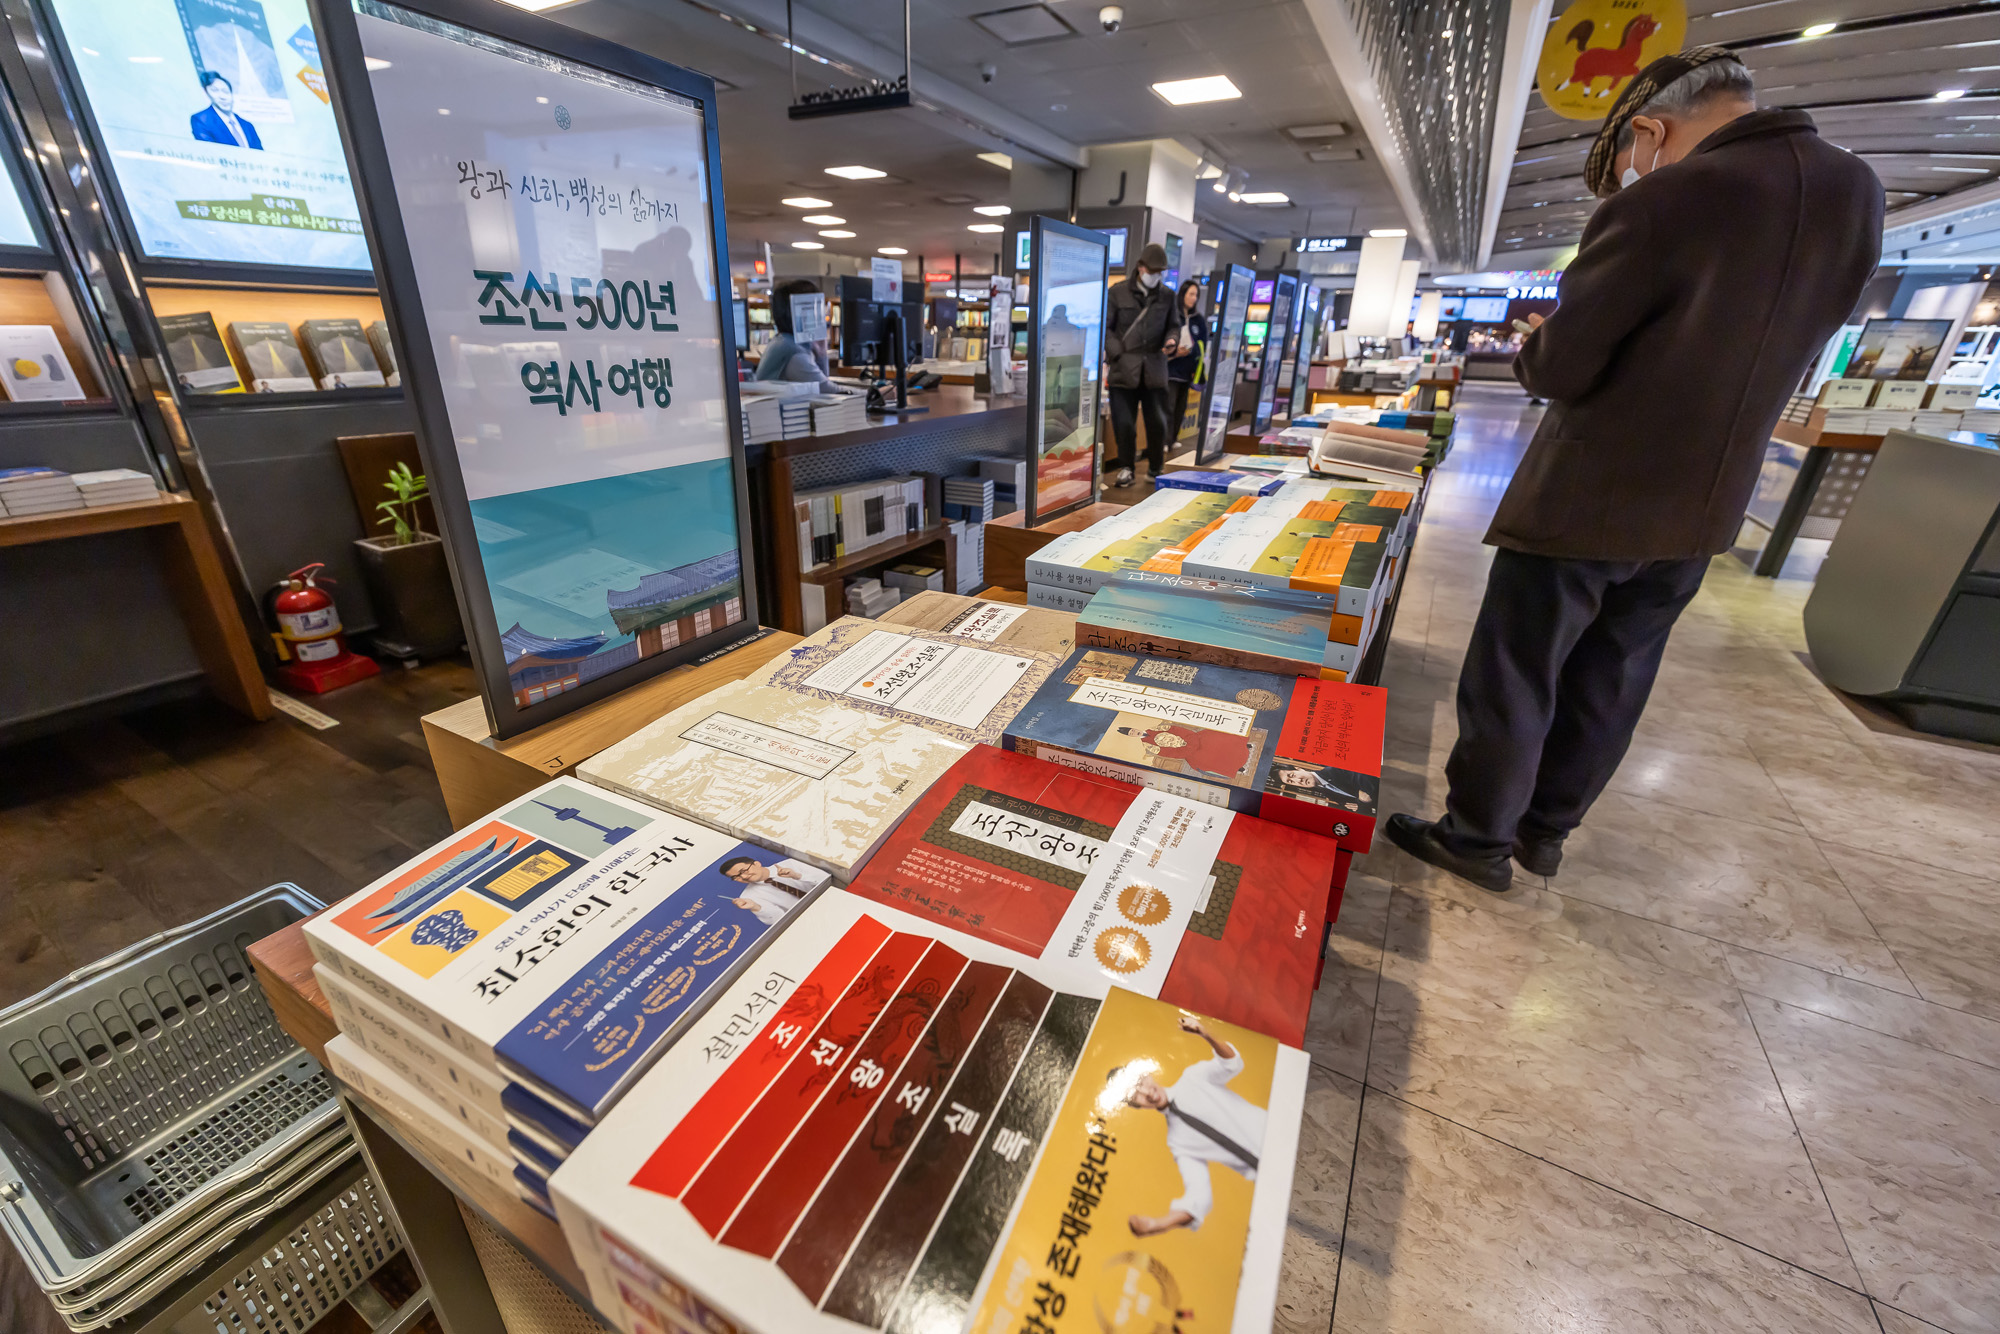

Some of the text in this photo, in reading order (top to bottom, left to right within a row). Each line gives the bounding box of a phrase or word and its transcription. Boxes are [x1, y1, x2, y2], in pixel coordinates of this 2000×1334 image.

[458, 160, 512, 199] 왕과
[629, 189, 678, 223] 삶까지
[1107, 170, 1127, 207] J
[211, 206, 252, 223] 당신의
[473, 270, 678, 331] 조선 500년
[521, 357, 673, 415] 역사 여행
[1035, 569, 1092, 586] 나 사용 설명서
[1047, 594, 1064, 605] 사용
[875, 646, 943, 698] 조선왕조실록
[1088, 692, 1232, 725] 조선왕조실록
[989, 793, 1005, 804] 한
[1006, 798, 1044, 817] 권으로
[1130, 825, 1147, 848] 오리지널
[1109, 864, 1125, 881] 독자가
[494, 850, 636, 952] 5천 년 역사가 단숨에 이해되는
[1093, 900, 1105, 911] 힘!
[1096, 880, 1115, 902] 200만
[478, 837, 694, 996] 최소한의 한국사
[1081, 912, 1099, 935] 고증의
[1066, 933, 1088, 959] 탄탄한
[540, 1018, 572, 1042] 역사
[567, 989, 603, 1019] 공부가
[599, 975, 618, 988] 더
[616, 956, 641, 975] 쉽고
[634, 917, 685, 958] 재미있었을
[545, 998, 575, 1020] 책이
[569, 979, 595, 999] 역사
[592, 928, 655, 977] 교과서였다면
[579, 919, 708, 1031] 20만 독자가 선택한 역사 베스트셀러
[704, 972, 795, 1060] 설민석의
